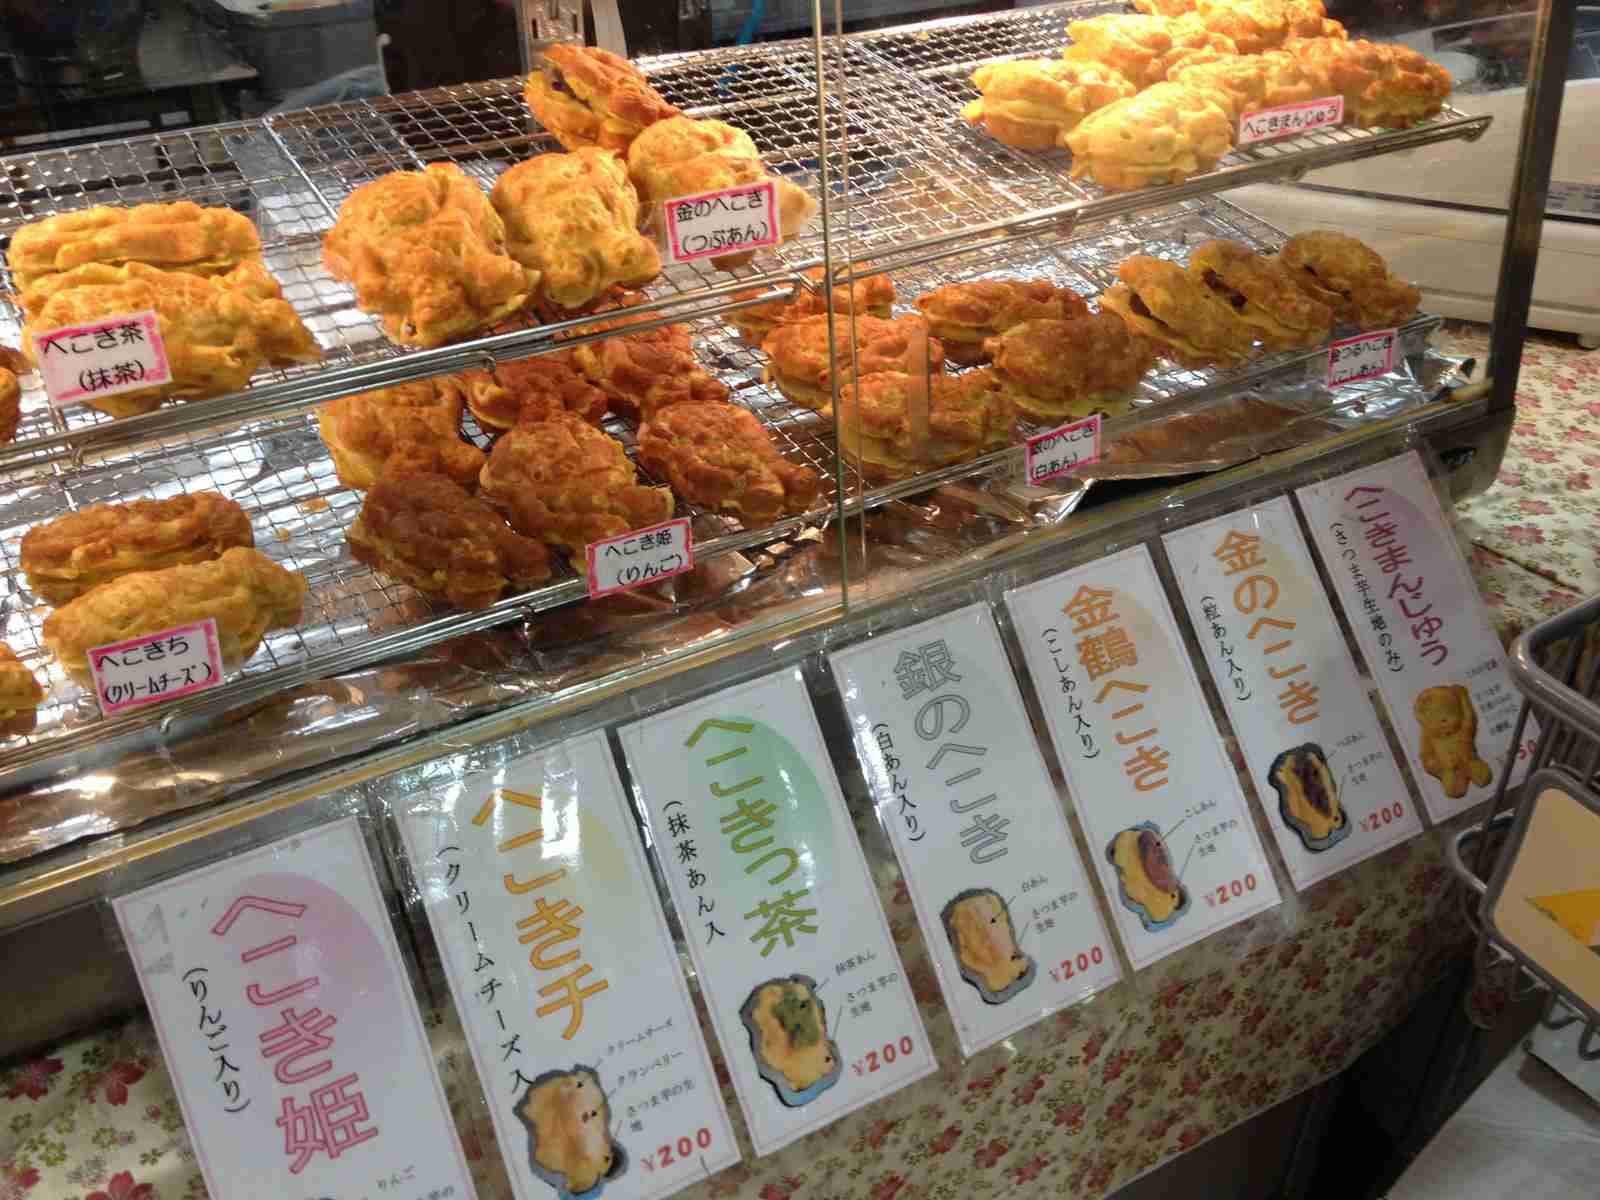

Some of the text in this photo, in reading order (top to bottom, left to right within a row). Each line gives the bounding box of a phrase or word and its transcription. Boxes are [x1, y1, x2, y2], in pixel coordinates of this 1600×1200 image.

[43, 321, 144, 354] へこき茶
[79, 359, 145, 391] (抹茶)
[1213, 529, 1321, 725] 金のへこき
[1344, 487, 1449, 666] へこきまんじゅう
[893, 639, 1011, 865] 銀のへこき
[210, 894, 379, 1175] へこき姫
[851, 1034, 914, 1076] ¥200
[640, 1127, 711, 1173] ¥200
